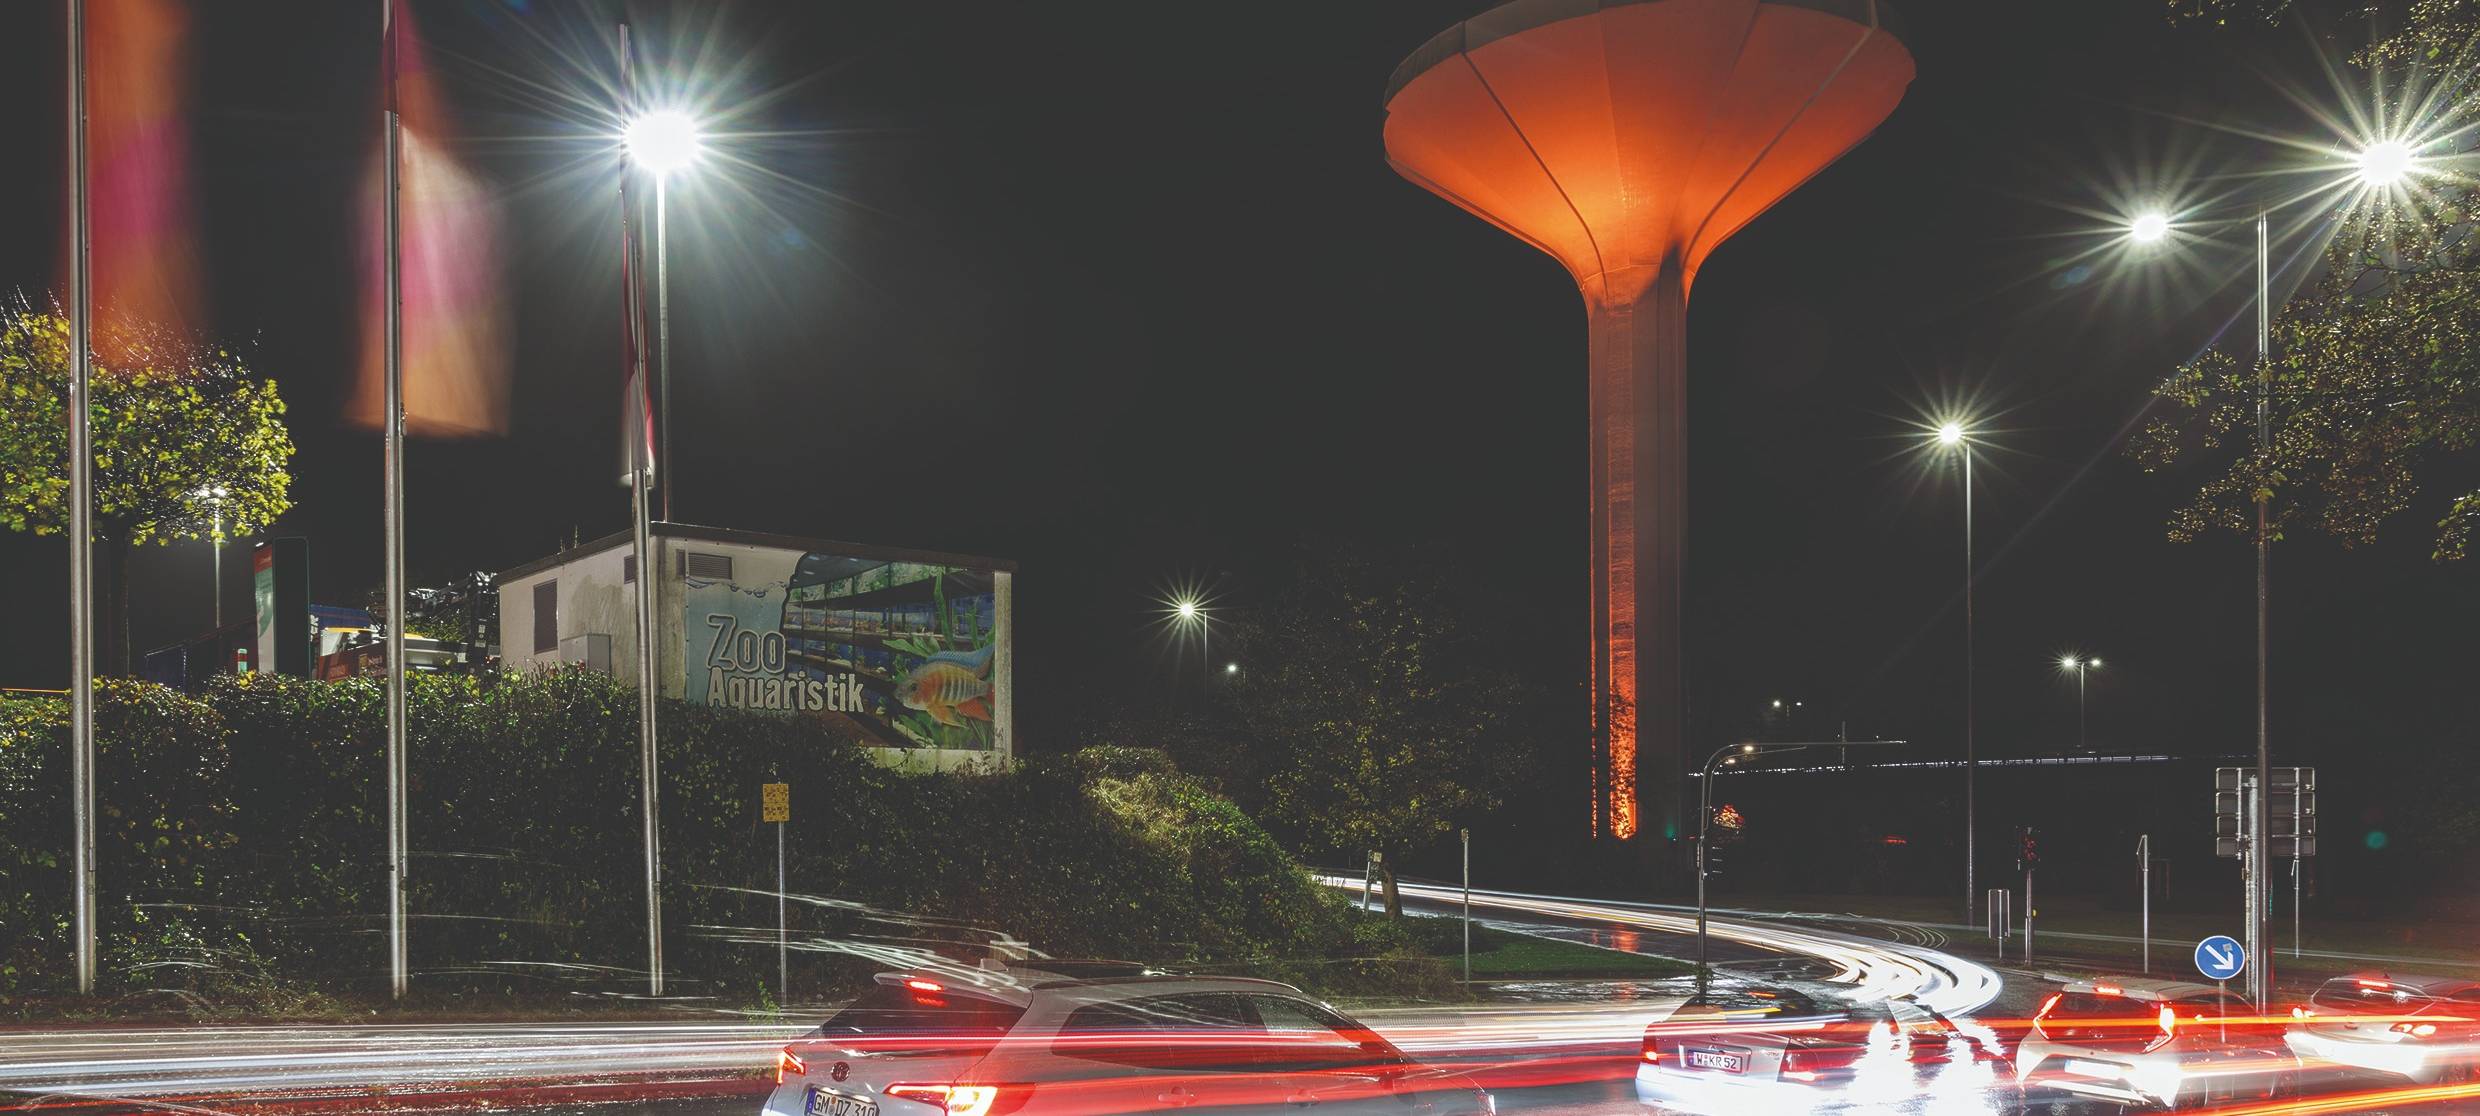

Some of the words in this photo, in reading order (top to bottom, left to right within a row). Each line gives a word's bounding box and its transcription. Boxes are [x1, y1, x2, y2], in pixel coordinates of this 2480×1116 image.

[706, 613, 786, 673] Zoo
[706, 667, 865, 713] Aquaristik
[1724, 1057, 1737, 1070] 52
[814, 1094, 830, 1114] GM
